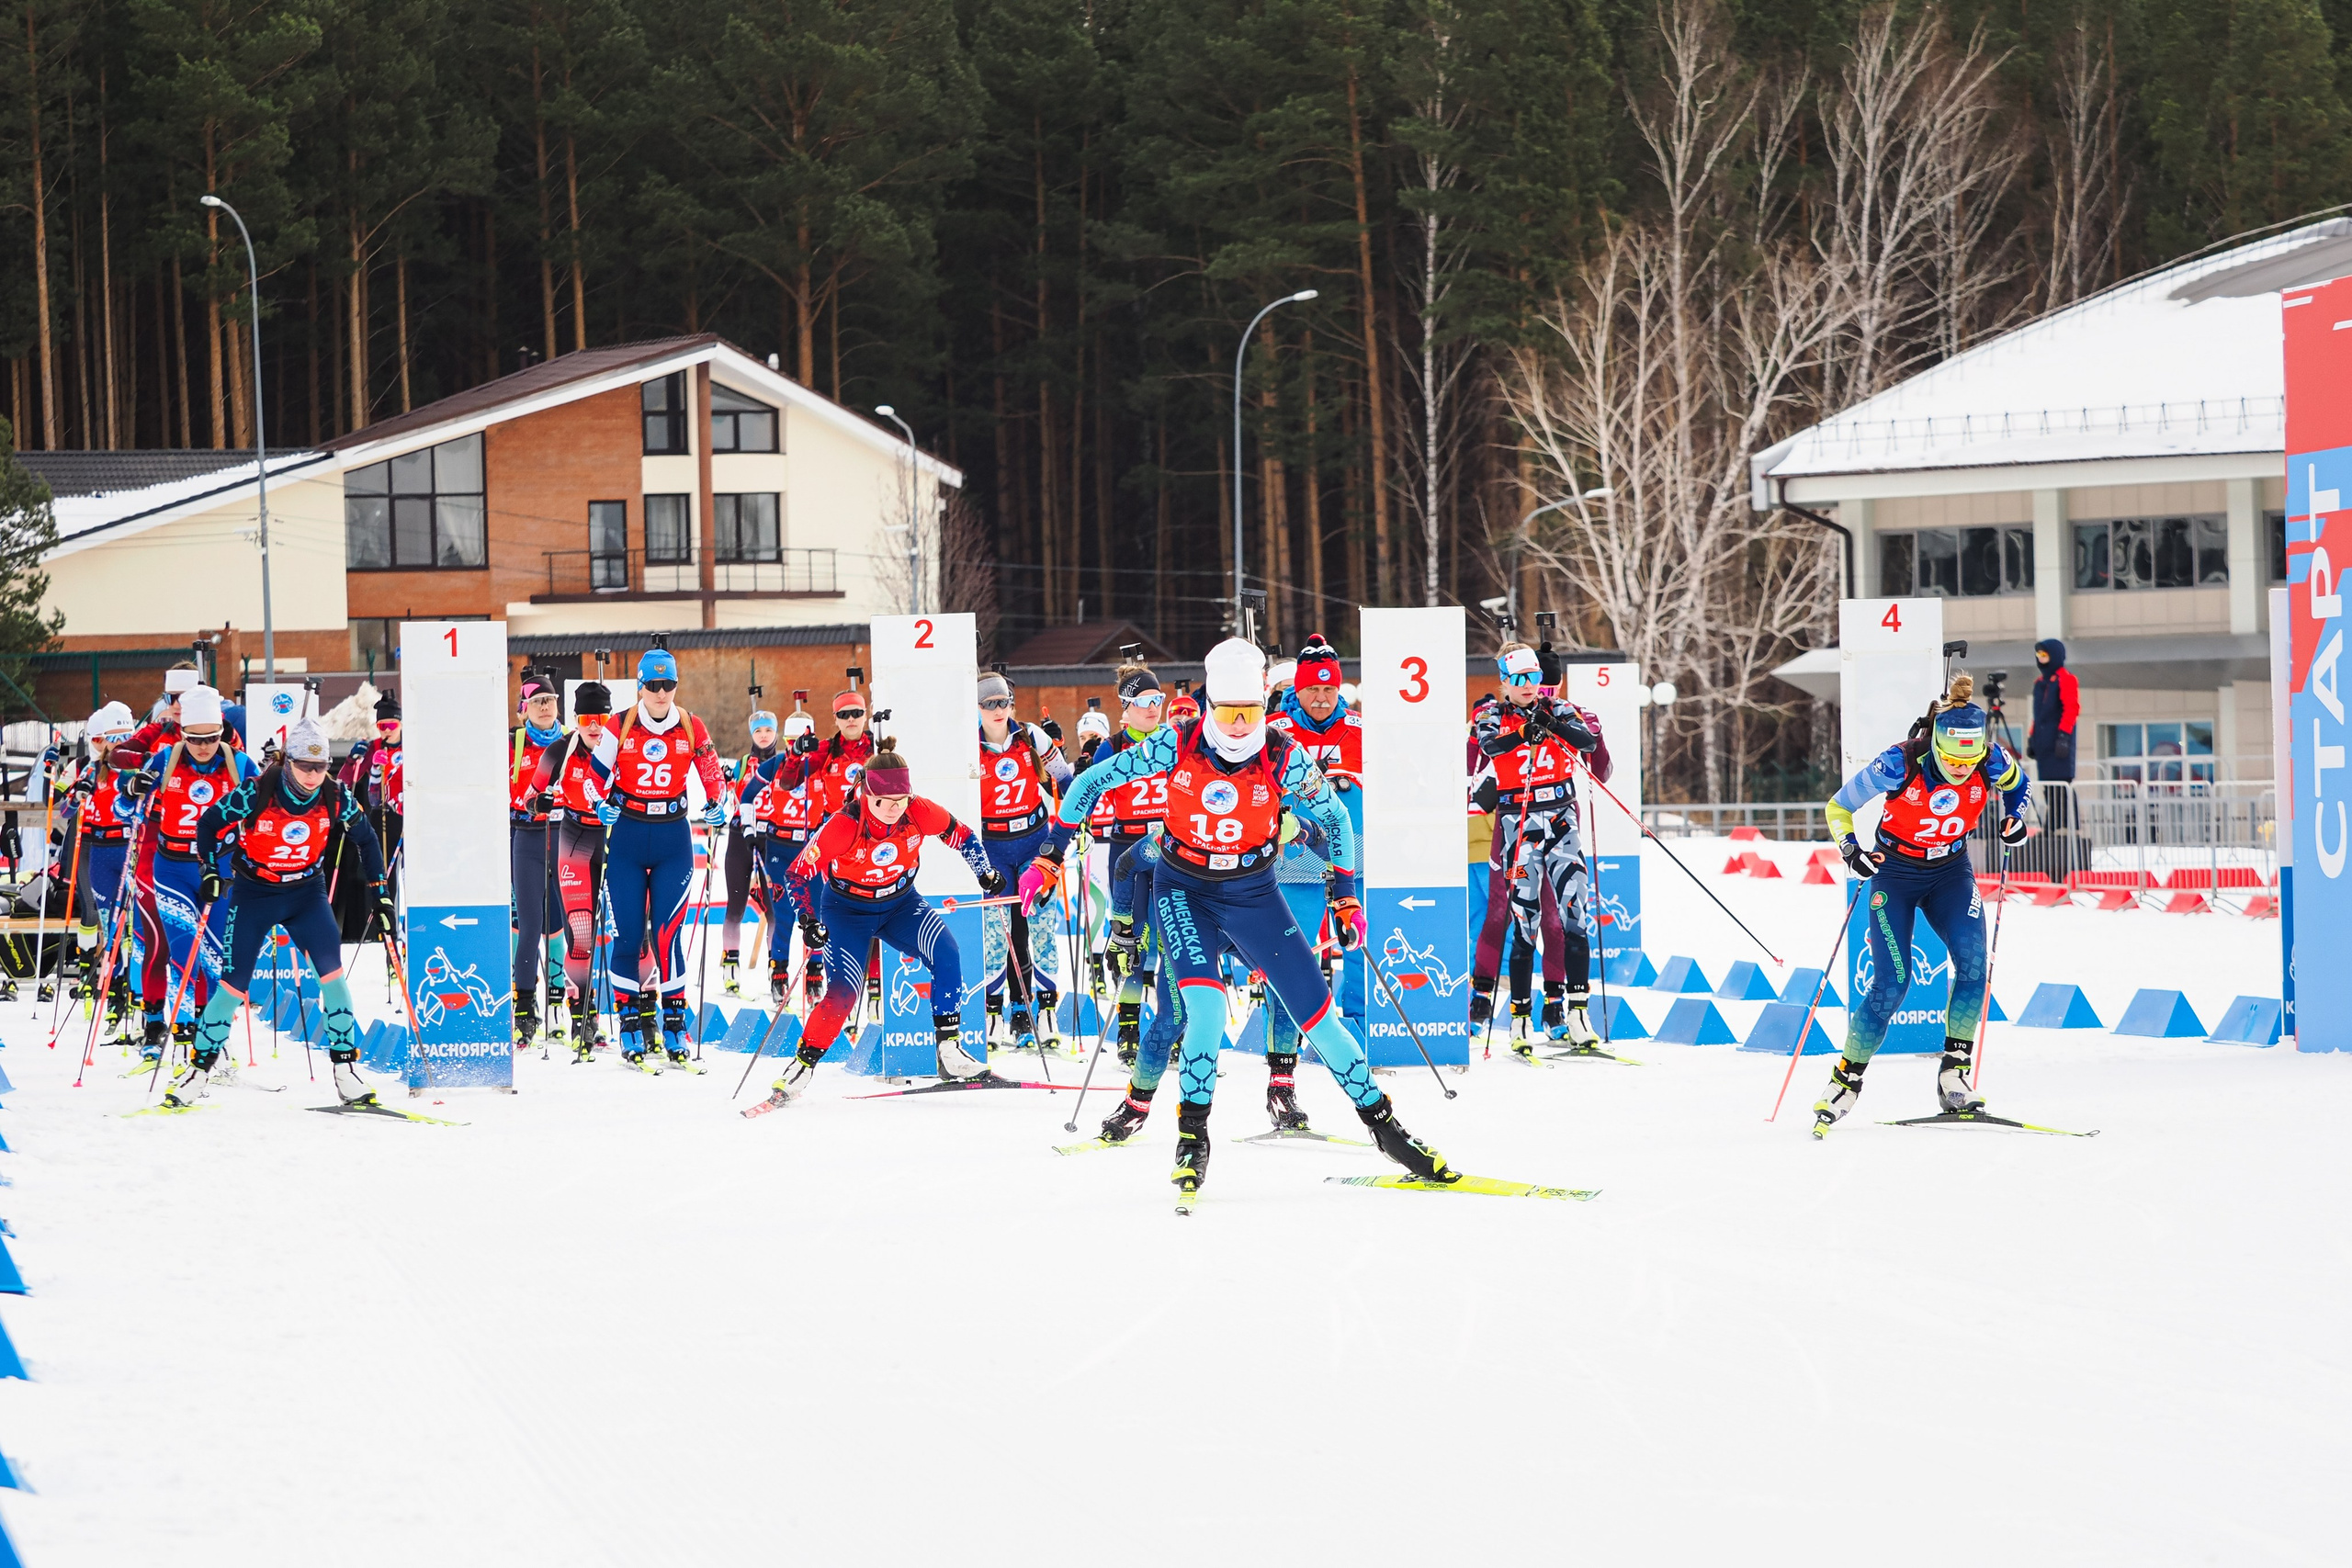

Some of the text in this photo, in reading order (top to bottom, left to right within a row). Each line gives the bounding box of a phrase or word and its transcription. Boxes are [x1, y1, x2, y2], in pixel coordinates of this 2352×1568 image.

[1881, 603, 1902, 633] 4
[443, 627, 458, 658] 1
[914, 619, 934, 649] 2
[1398, 656, 1430, 704] 3
[1597, 667, 1610, 687] 5
[2308, 462, 2347, 879] СТАРТ
[276, 724, 287, 744] 1
[637, 762, 672, 787] 26
[1517, 746, 1555, 775] 24
[994, 778, 1027, 806] 27
[1131, 777, 1169, 807] 23
[783, 799, 812, 818] 47
[995, 805, 1029, 815] КРАСНОЯРСК
[1189, 814, 1244, 843] 18
[1914, 816, 1965, 838] 20
[268, 845, 311, 861] 21
[1158, 897, 1183, 961] ОБЛАСТЬ
[1876, 908, 1905, 984] БЕЛОРУСНЕФТЬ
[886, 1030, 984, 1047] КРАСНРСК
[1369, 1021, 1467, 1039] КРАСНОЯРСК
[410, 1042, 510, 1058] КРАСНОЯРСК
